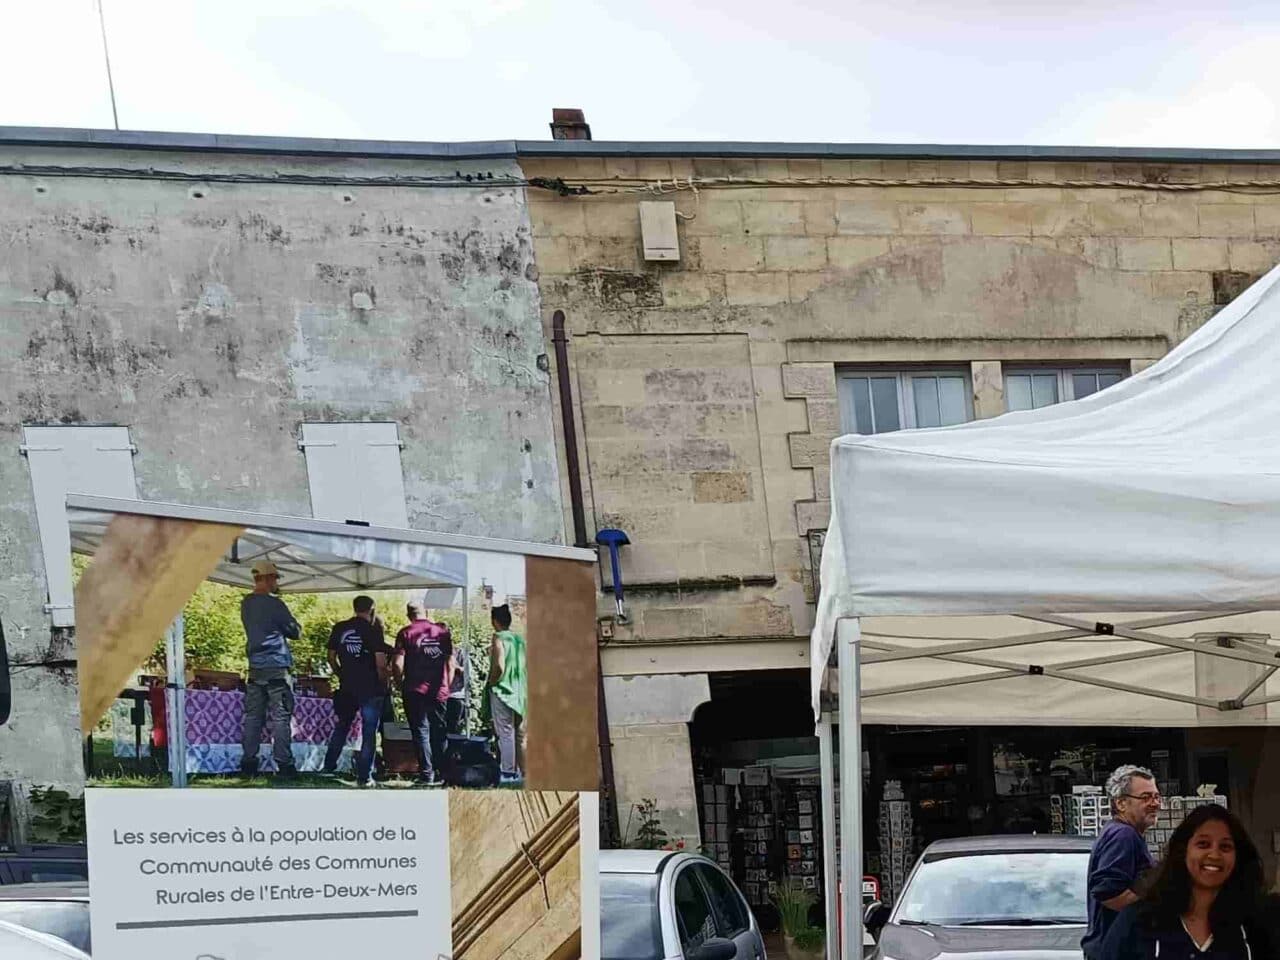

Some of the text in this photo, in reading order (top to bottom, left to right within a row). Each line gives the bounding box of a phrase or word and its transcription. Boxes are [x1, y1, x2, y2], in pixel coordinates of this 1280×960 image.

[113, 826, 416, 845] Les services à la population de la
[140, 855, 417, 875] Communauté des Communes
[156, 882, 417, 905] Rurales de l'Entre-Deux-Mers
